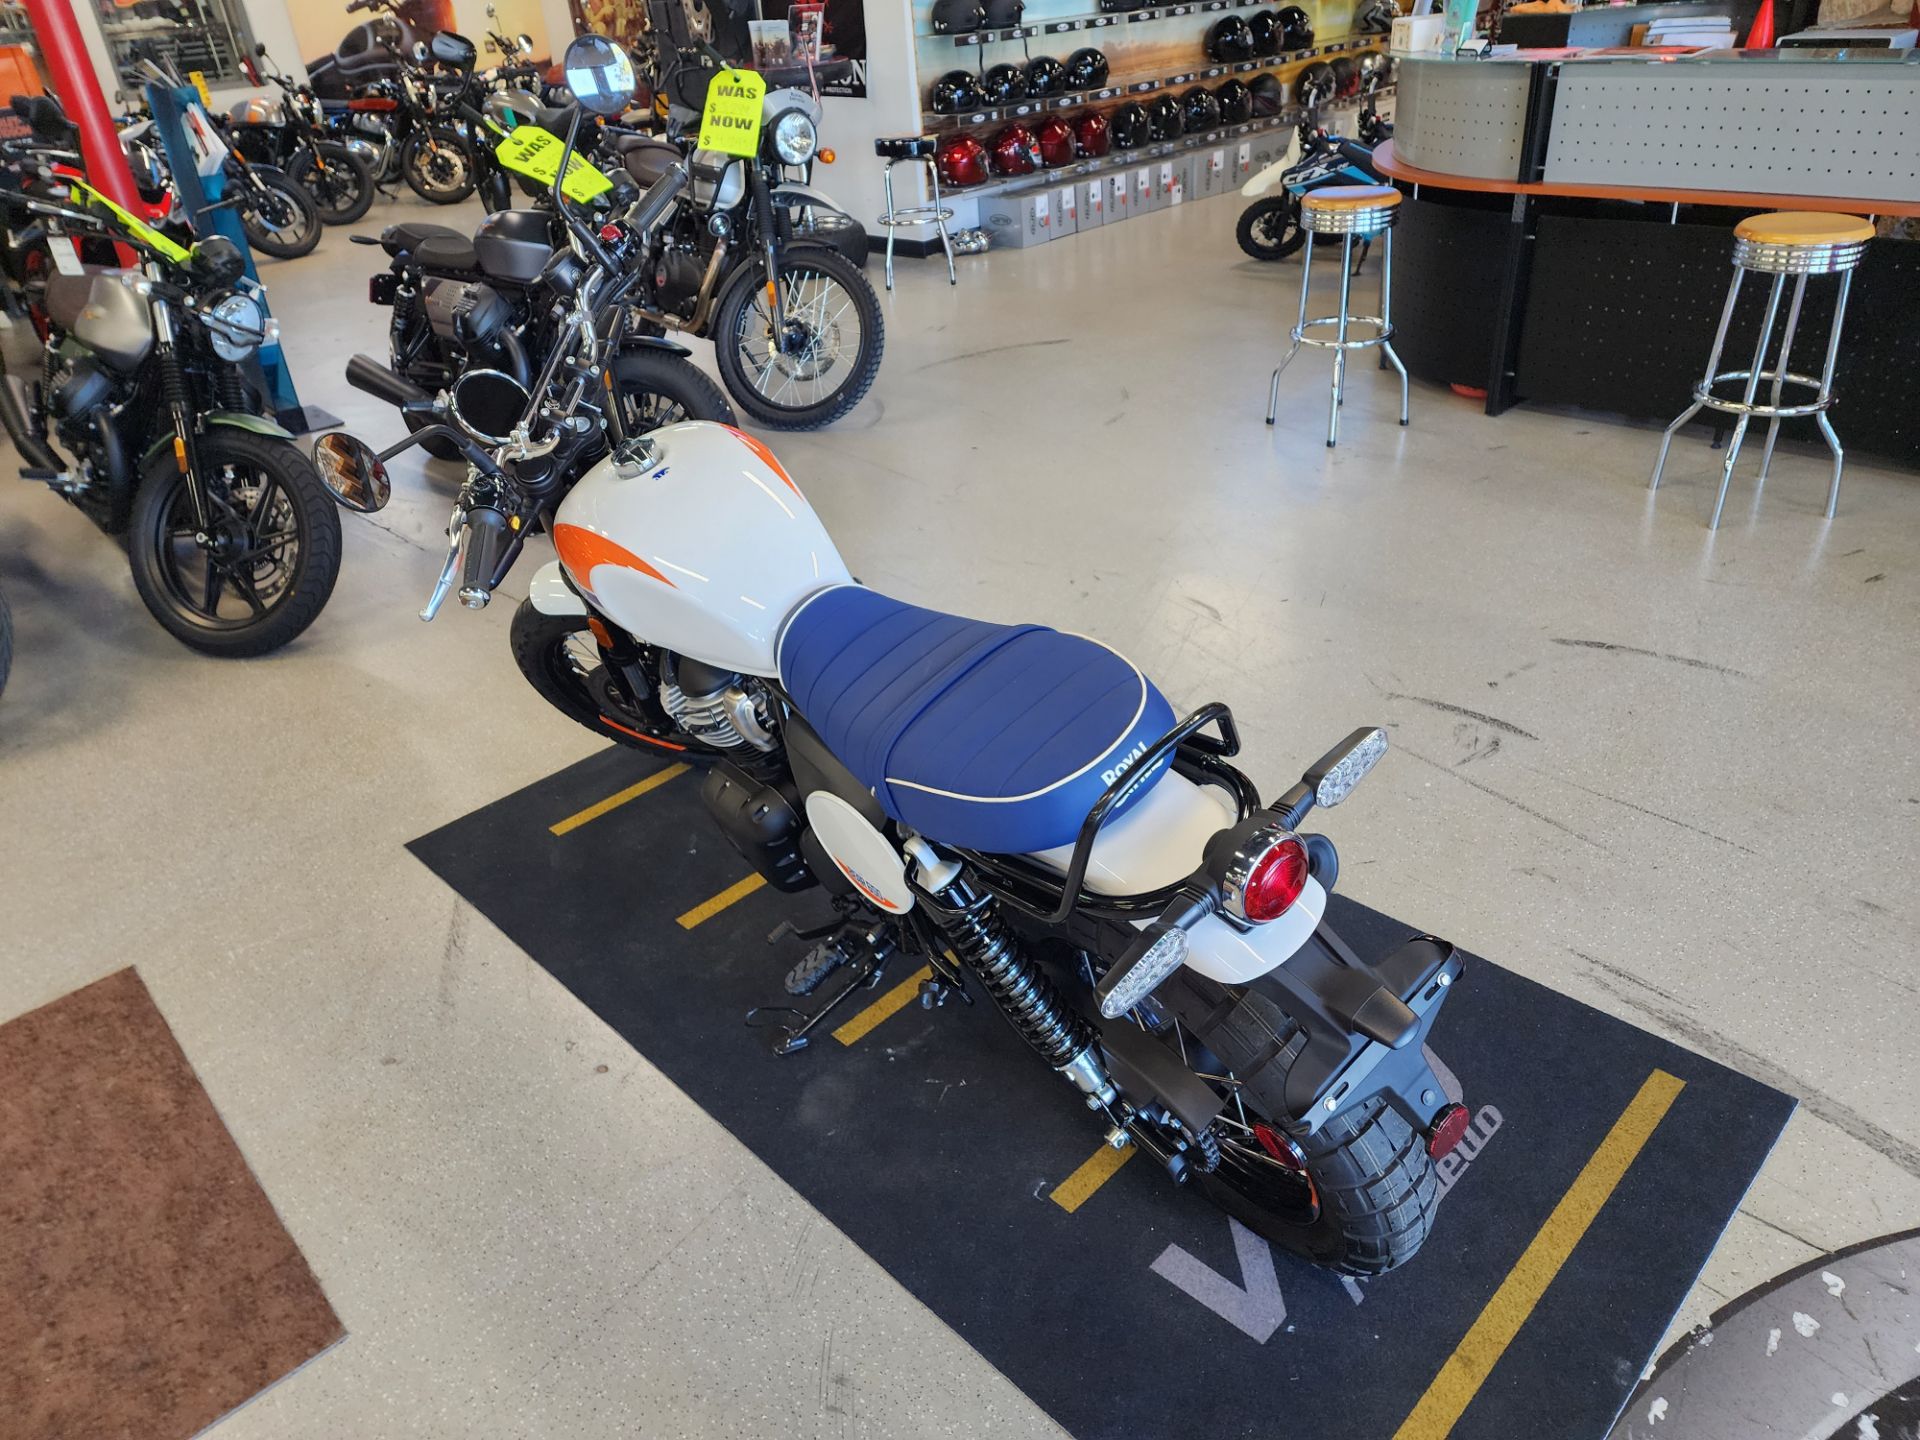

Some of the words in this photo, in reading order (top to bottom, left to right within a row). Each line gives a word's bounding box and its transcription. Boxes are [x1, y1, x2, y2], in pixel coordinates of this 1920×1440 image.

[717, 85, 757, 99] WAS
[709, 102, 717, 113] $
[710, 114, 754, 131] NOW
[703, 135, 711, 146] $
[514, 135, 552, 163] WAS
